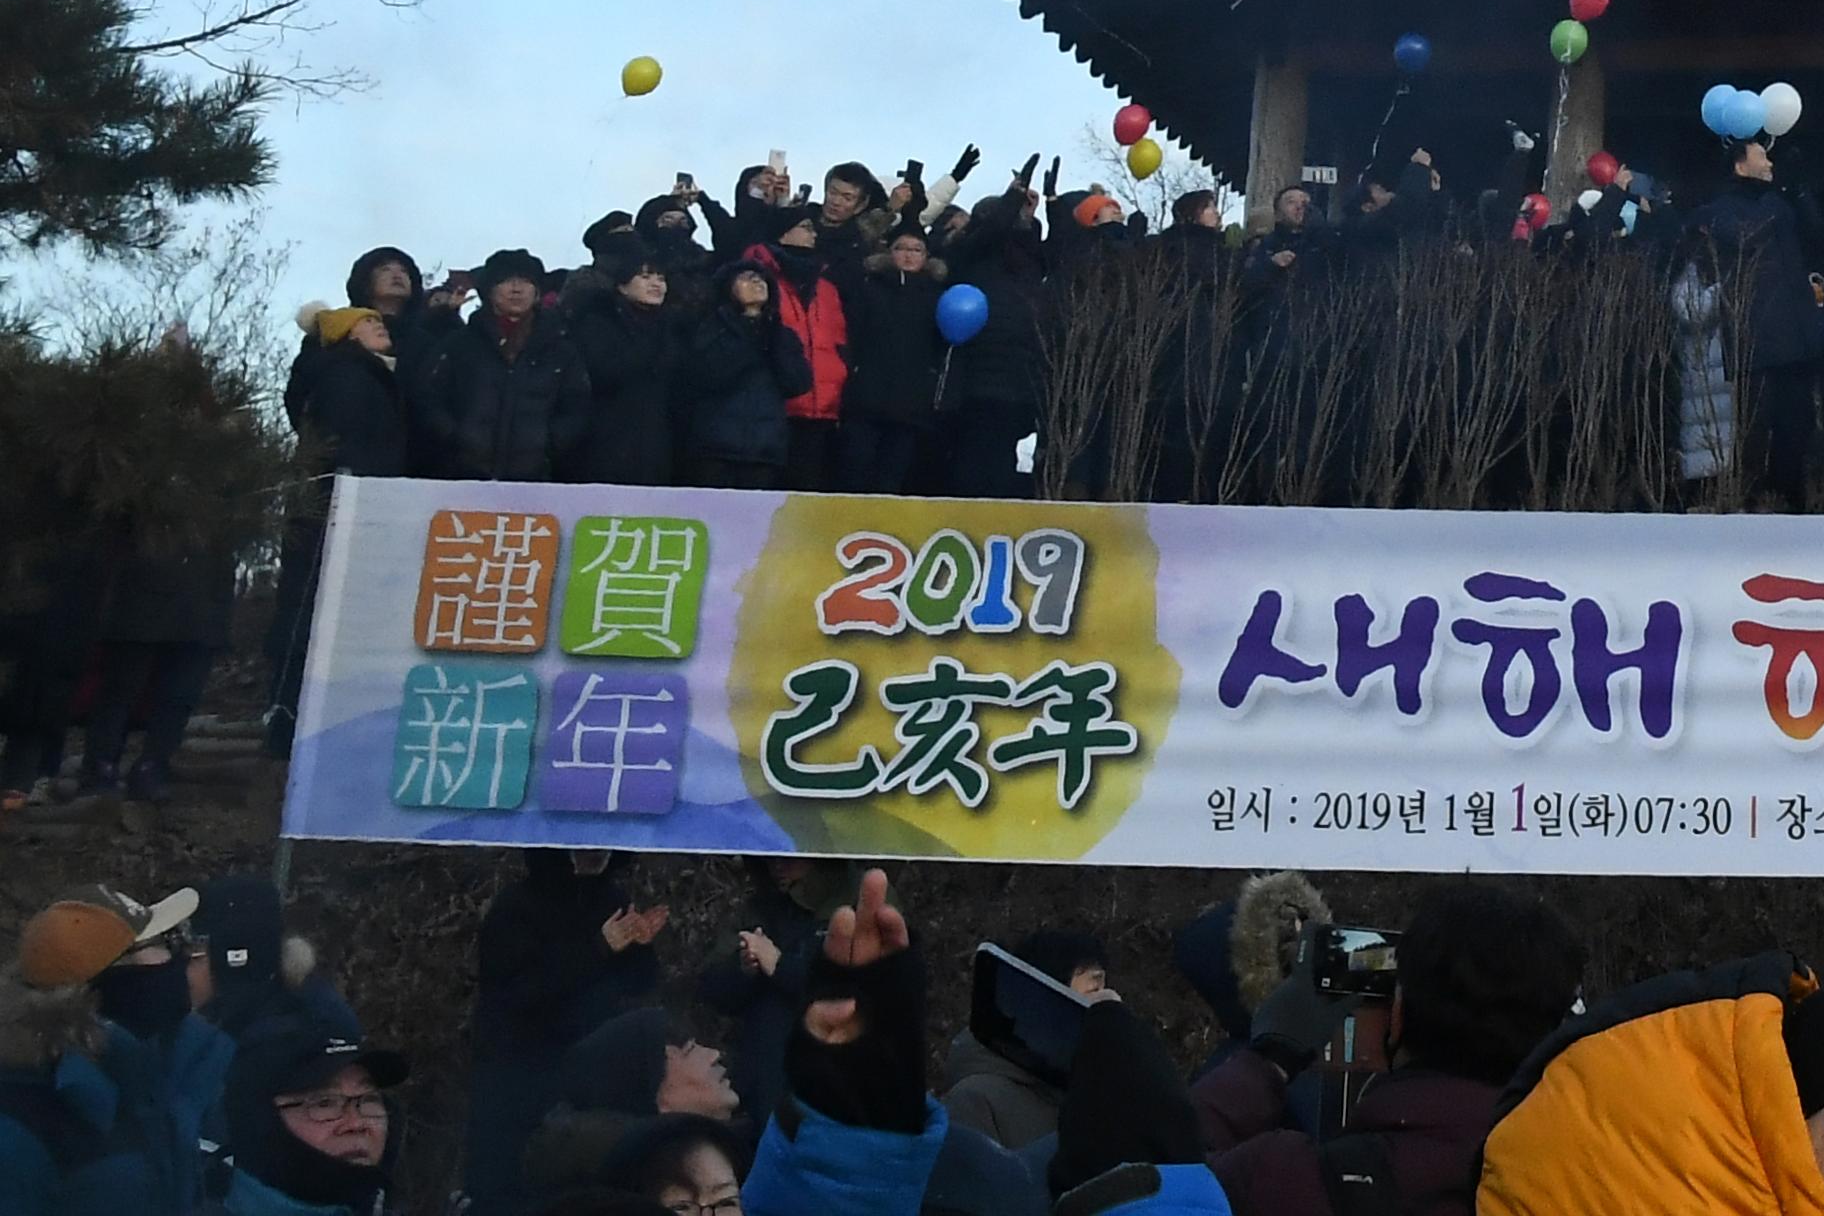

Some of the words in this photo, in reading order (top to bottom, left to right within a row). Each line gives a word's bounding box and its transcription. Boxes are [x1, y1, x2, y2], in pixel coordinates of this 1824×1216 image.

[818, 530, 1083, 635] 2019
[1218, 571, 1683, 739] 새해
[762, 658, 1137, 810] 己亥年
[1313, 789, 1427, 835] 2019년
[1444, 790, 1495, 836] 1월
